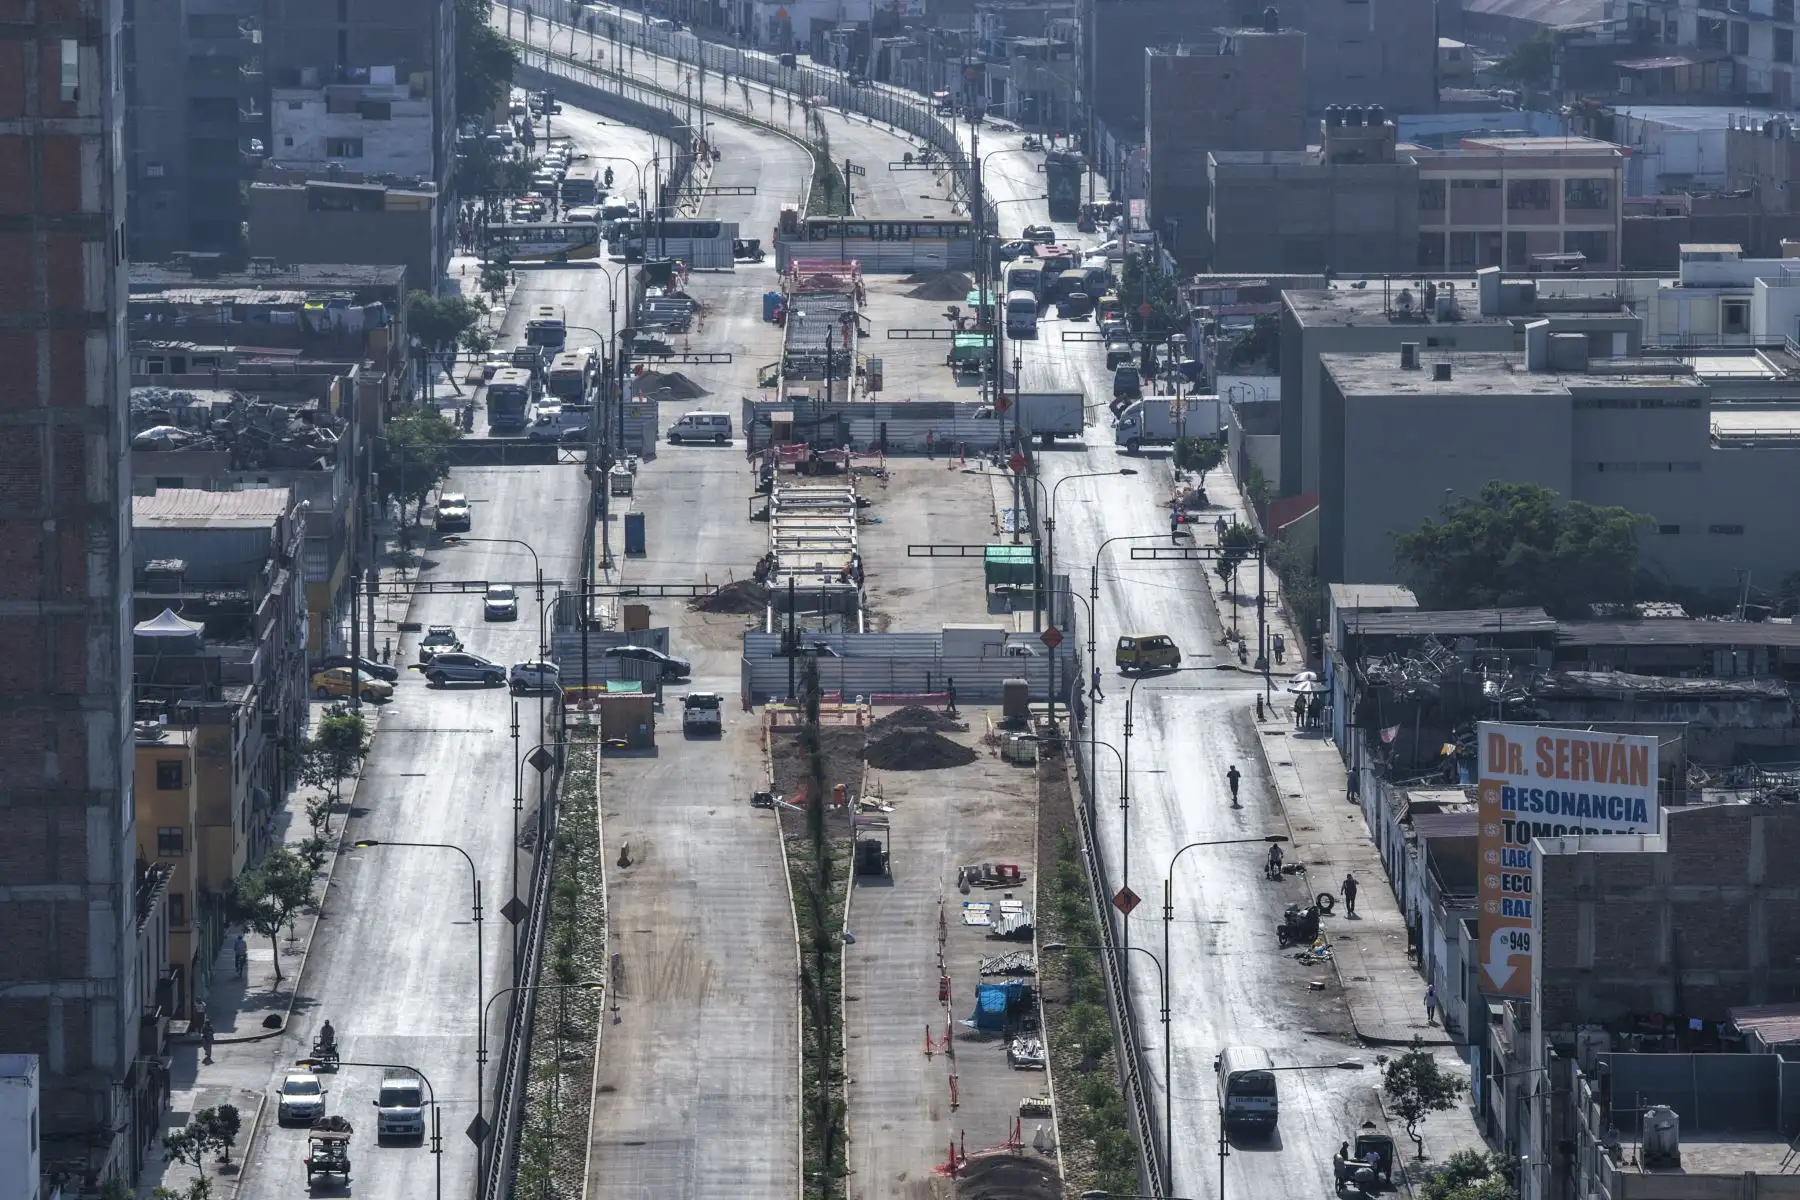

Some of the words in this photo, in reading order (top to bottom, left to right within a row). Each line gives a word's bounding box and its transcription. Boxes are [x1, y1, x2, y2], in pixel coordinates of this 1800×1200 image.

[1536, 736, 1649, 787] SERVÁN
[1501, 786, 1649, 823] RESONANCIA
[1502, 873, 1532, 893] ECO
[1509, 931, 1530, 952] 949
